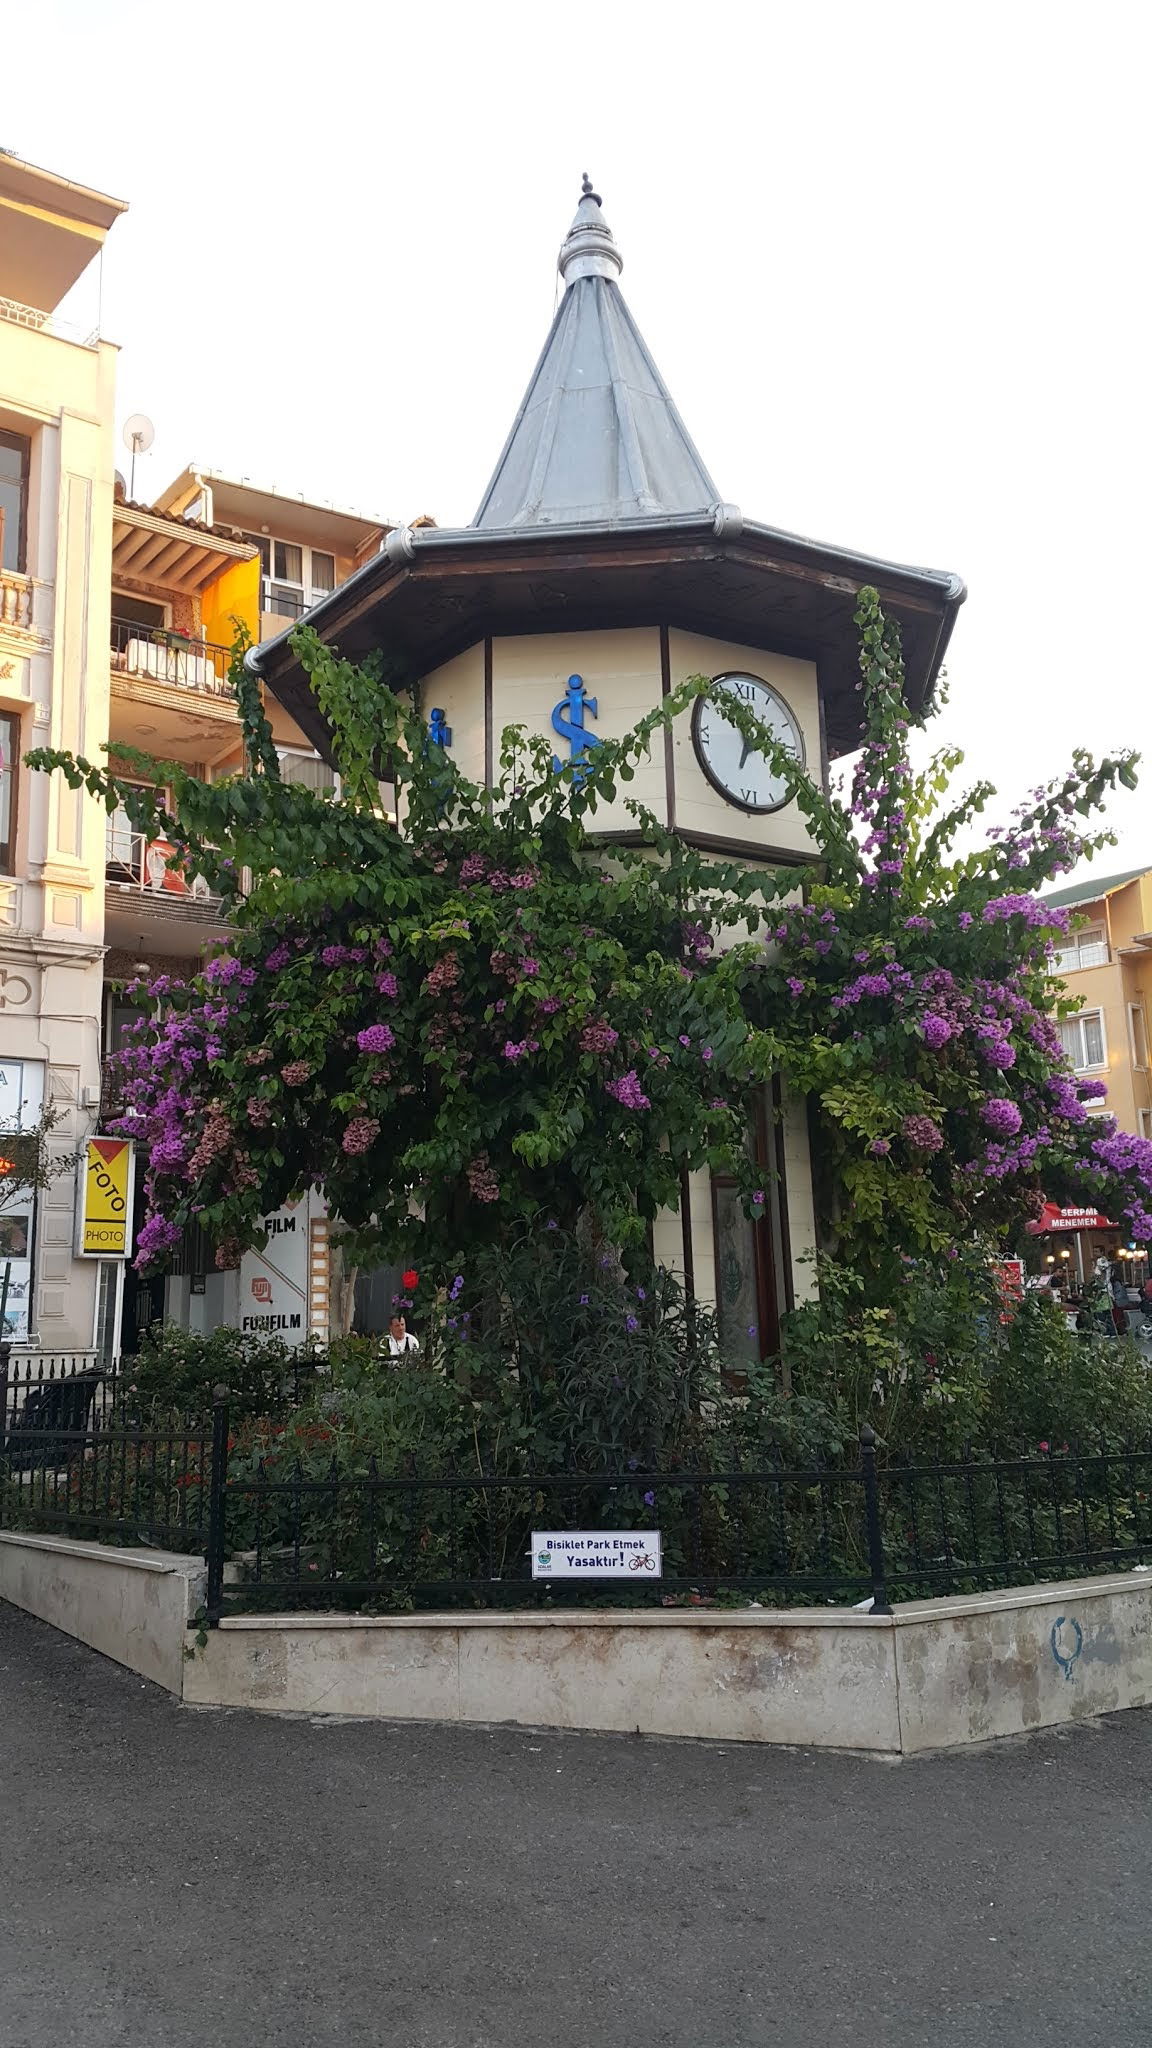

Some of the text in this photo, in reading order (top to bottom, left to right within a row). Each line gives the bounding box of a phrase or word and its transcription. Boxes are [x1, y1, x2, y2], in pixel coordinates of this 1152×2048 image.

[734, 682, 757, 701] XII
[88, 1161, 125, 1212] FOTO
[264, 1217, 296, 1233] FILM
[1051, 1217, 1097, 1227] MENEMEN
[86, 1230, 124, 1242] PHOTO
[546, 1539, 645, 1550] Bisiklet Park Etmek
